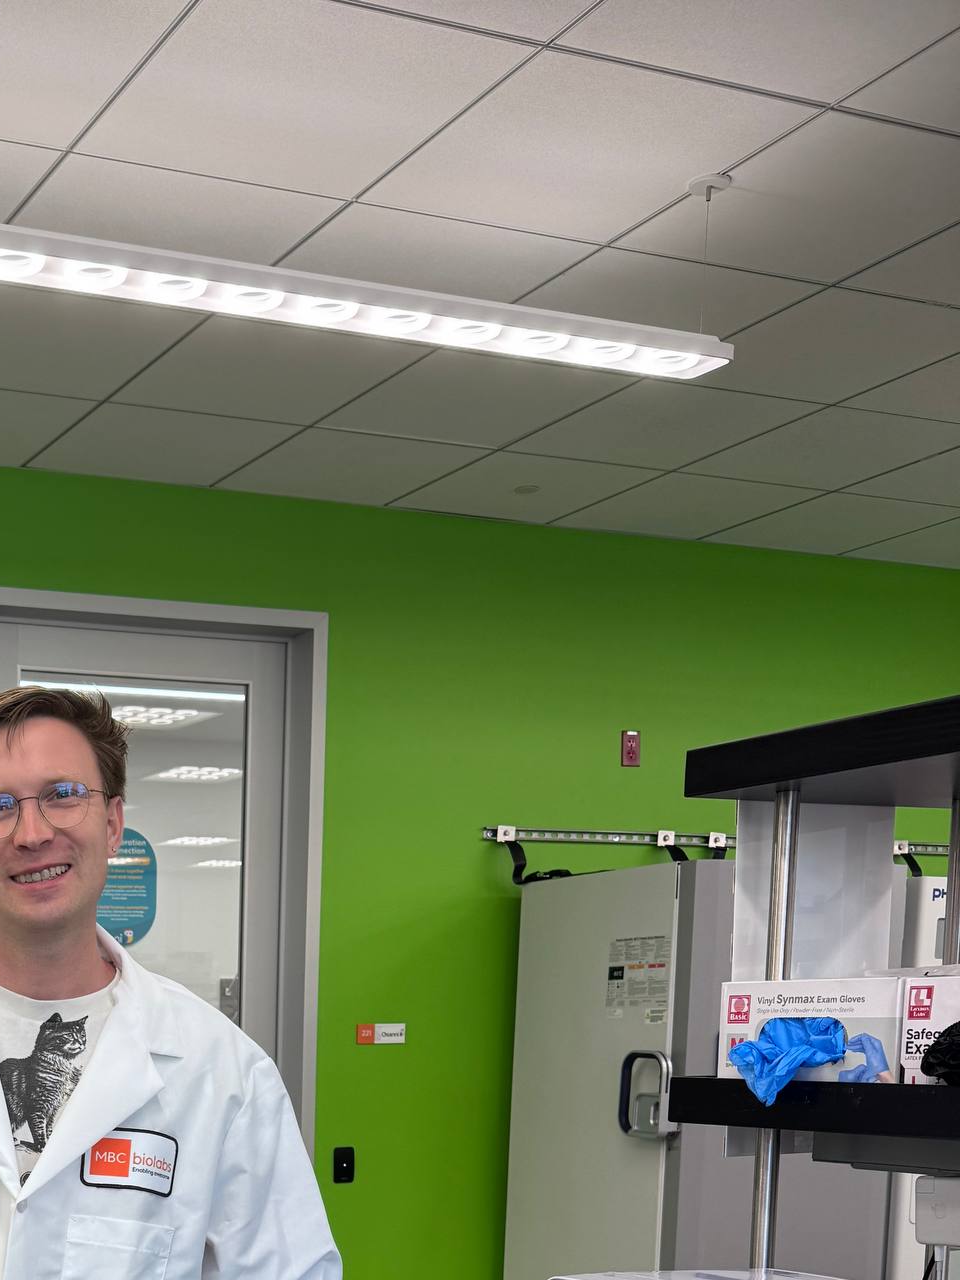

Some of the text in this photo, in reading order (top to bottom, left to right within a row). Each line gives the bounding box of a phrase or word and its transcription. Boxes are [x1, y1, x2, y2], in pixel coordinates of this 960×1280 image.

[757, 994, 866, 1007] Vinyl Synmax Exam Gloves
[95, 1151, 172, 1172] MBC biolabs
[132, 1166, 154, 1176] Enabling
